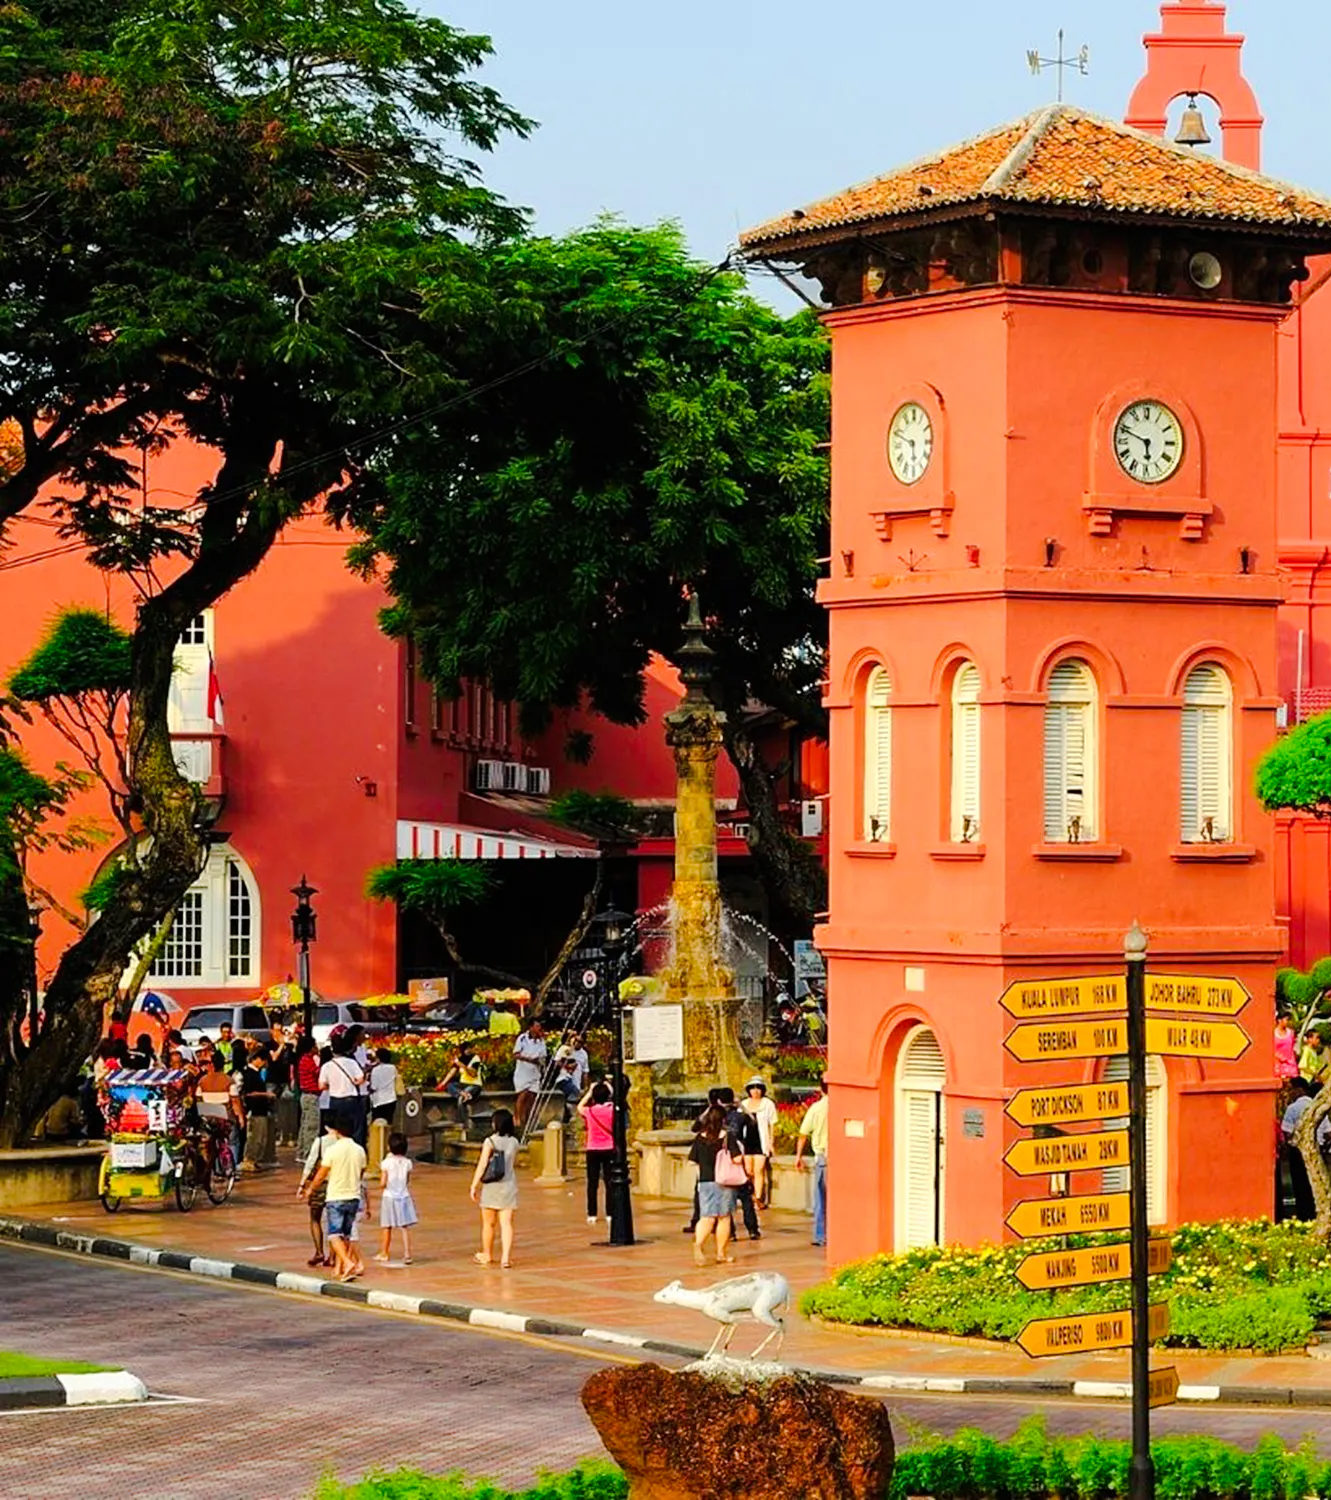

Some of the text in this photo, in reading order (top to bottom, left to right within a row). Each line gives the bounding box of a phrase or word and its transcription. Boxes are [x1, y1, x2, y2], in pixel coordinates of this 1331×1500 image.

[1021, 989, 1047, 1010] KUALA
[1049, 986, 1080, 1008] LUMPUR
[1105, 983, 1118, 1003] KM
[1150, 983, 1173, 1003] JOHOR
[1177, 984, 1202, 1006] BAHRU
[1221, 988, 1233, 1009] KM
[1038, 1029, 1078, 1052] SEREMBAN
[1106, 1026, 1118, 1048] KM
[1167, 1027, 1187, 1048] MUAR
[1200, 1028, 1212, 1049] KM
[1031, 1096, 1050, 1118] PORT
[1051, 1093, 1084, 1116] DICKSON
[1108, 1090, 1119, 1110] KM
[1034, 1144, 1061, 1166] MASJID
[1061, 1142, 1088, 1163] TANAH
[1040, 1205, 1068, 1229] MEKAH
[1046, 1256, 1077, 1280] NANJING
[1108, 1251, 1119, 1273] KM
[1113, 1320, 1123, 1340] KM
